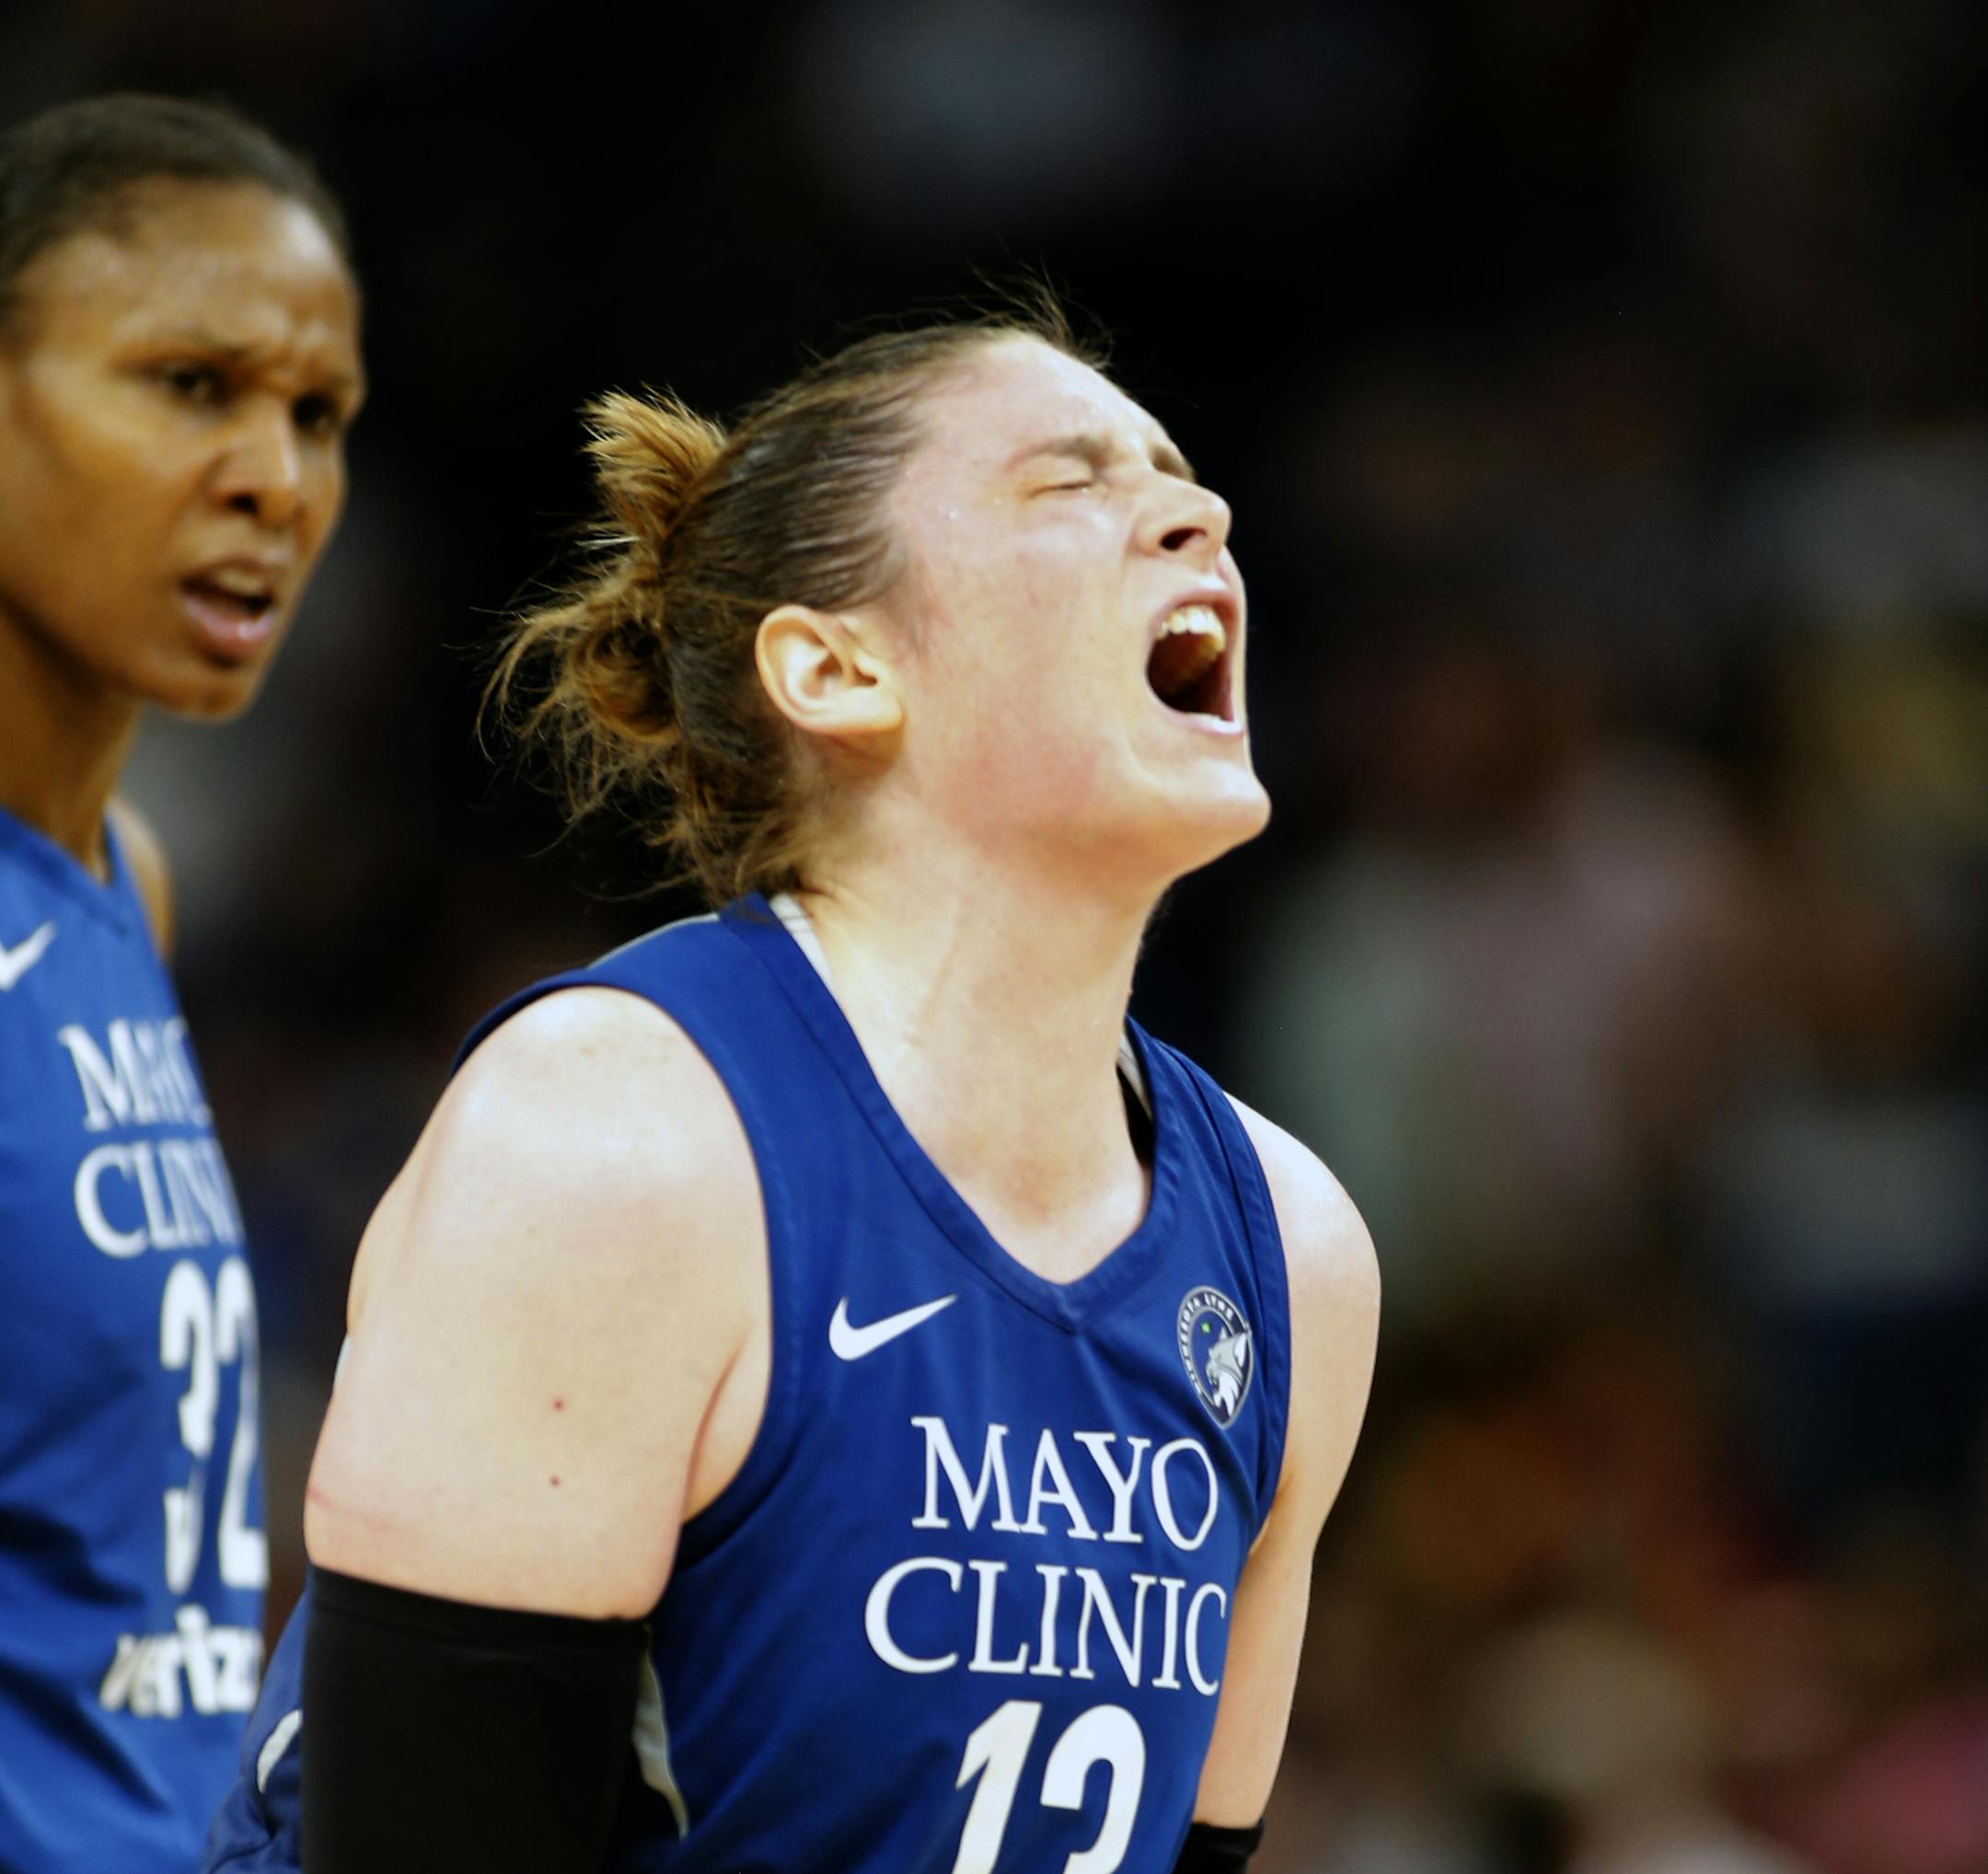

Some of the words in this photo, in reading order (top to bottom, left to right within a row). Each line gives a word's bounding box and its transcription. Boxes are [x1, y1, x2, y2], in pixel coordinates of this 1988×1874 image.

[159, 1257, 269, 1595] 32
[910, 1416, 1219, 1551] MAYO
[864, 1556, 1227, 1696] CLINIC
